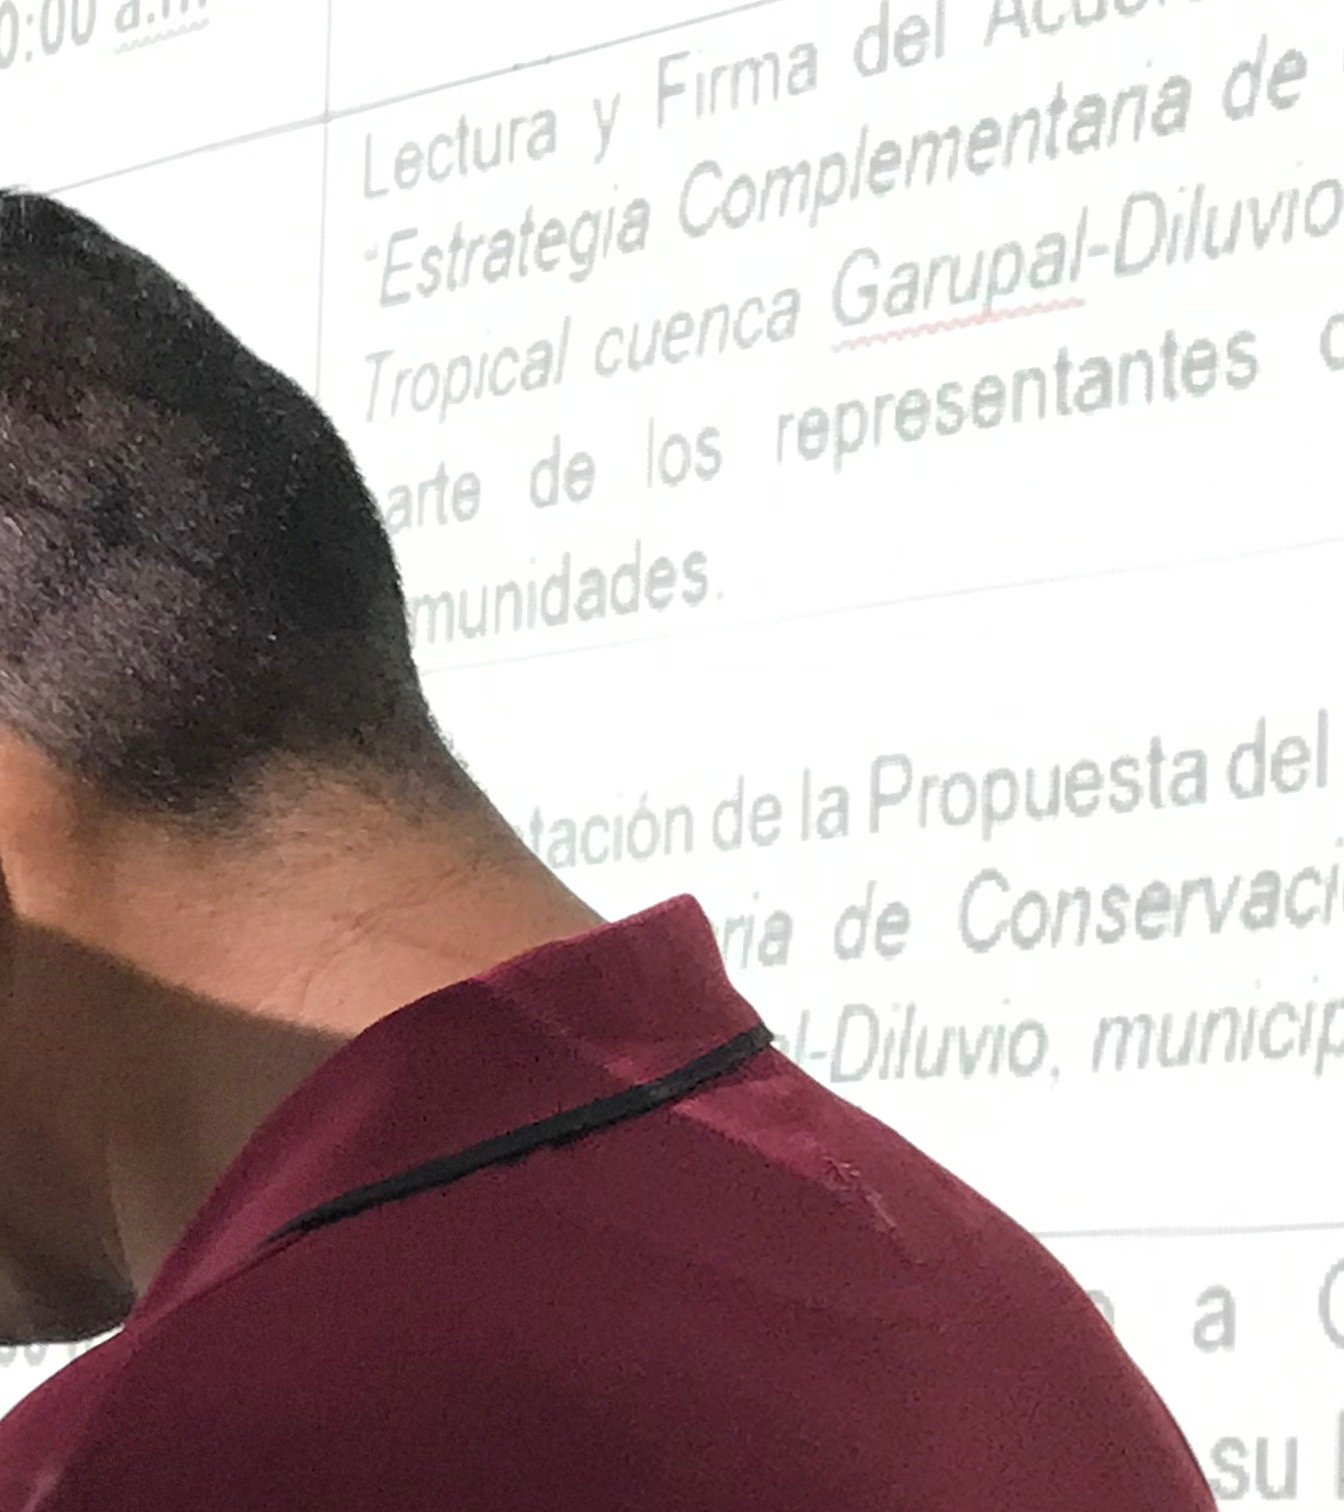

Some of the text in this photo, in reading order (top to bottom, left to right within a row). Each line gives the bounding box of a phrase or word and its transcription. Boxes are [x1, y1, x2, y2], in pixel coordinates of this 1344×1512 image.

[364, 97, 557, 199] Lectura
[593, 92, 621, 164] y
[656, 41, 819, 128] Firma
[853, 0, 946, 77] del
[679, 60, 1193, 238] Complementaria
[1222, 33, 1308, 121] de
[365, 161, 1344, 424] Tropical cuenca Garupal-Diluvio
[382, 460, 481, 534] arte
[530, 435, 596, 509] de
[647, 416, 723, 488] los
[776, 328, 1258, 471] representantes
[409, 538, 725, 648] munidades.
[515, 707, 1330, 870] tación de la Propuesta del
[715, 834, 1344, 969] ria de Conservaci
